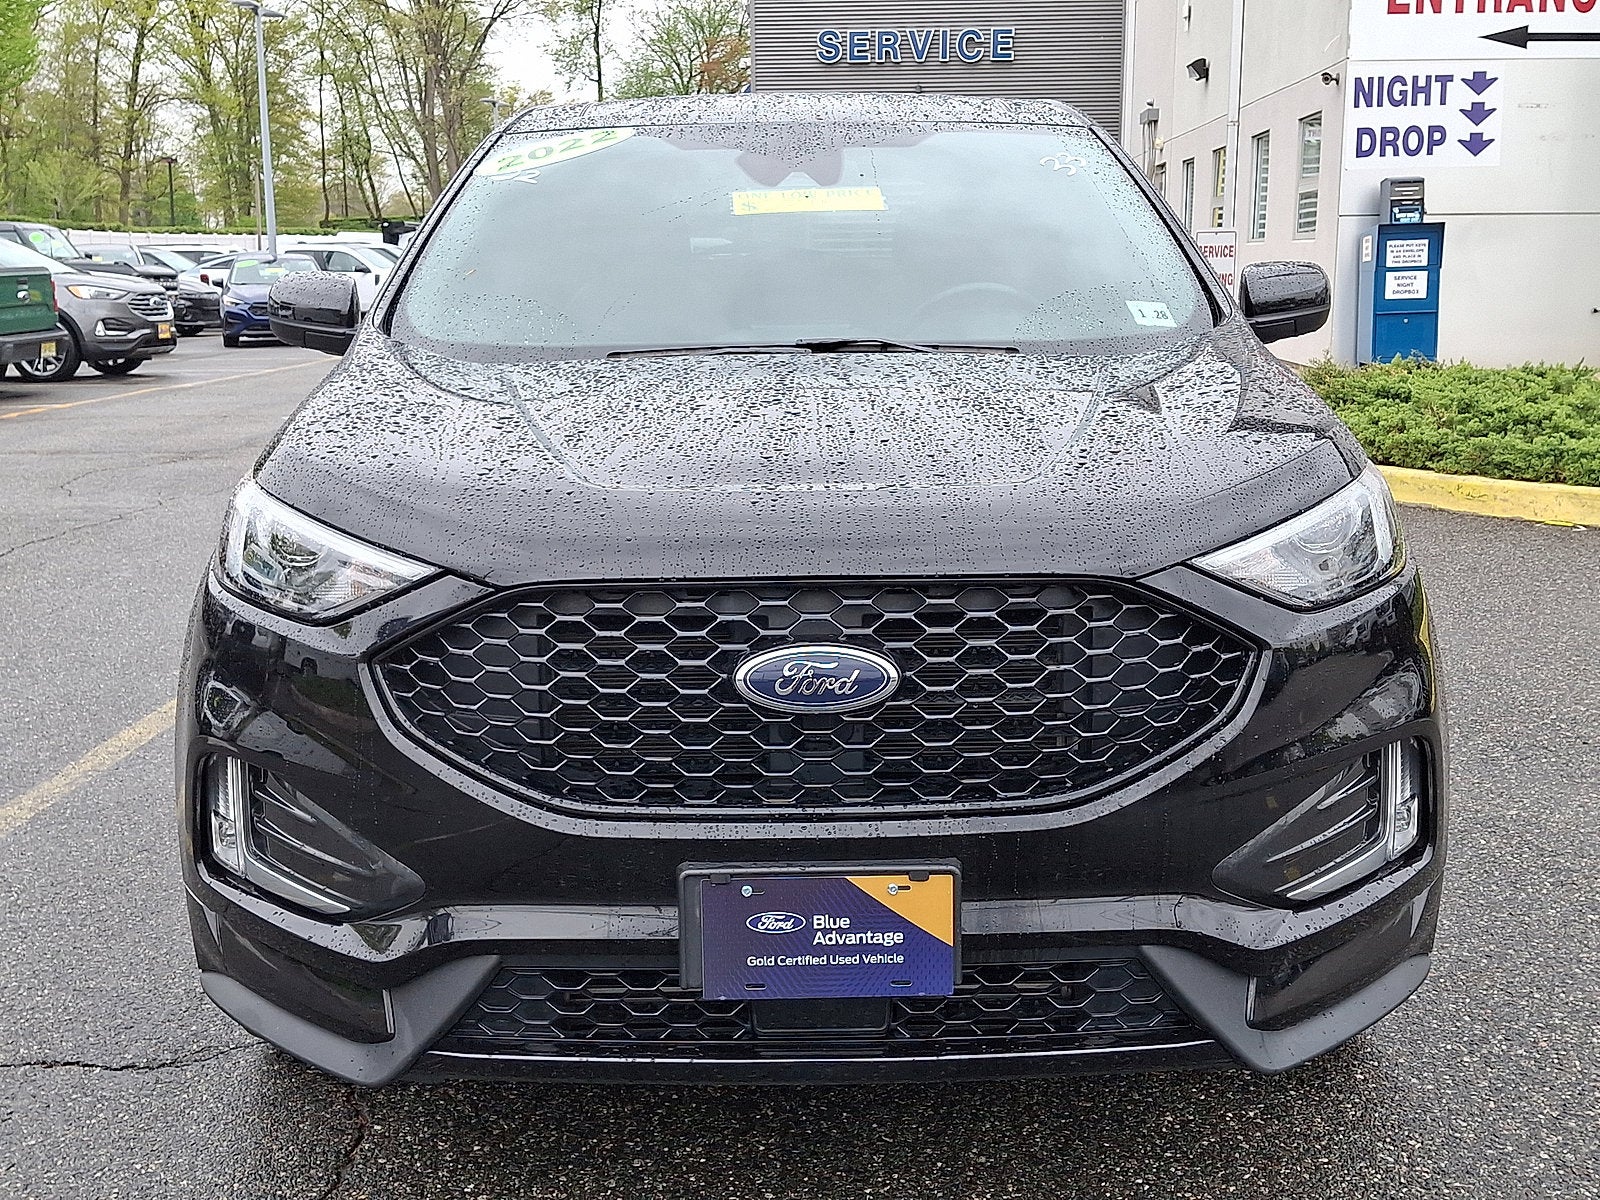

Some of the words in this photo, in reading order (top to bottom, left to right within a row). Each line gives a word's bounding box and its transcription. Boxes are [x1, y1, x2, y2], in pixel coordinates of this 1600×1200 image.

[816, 27, 1016, 64] SERVICE
[1353, 74, 1454, 108] NIGHT
[497, 130, 618, 172] 2022
[1356, 125, 1447, 158] DROP
[1154, 310, 1168, 320] 28
[774, 660, 860, 696] Ford
[757, 915, 795, 930] Ford
[813, 915, 850, 929] Blue
[812, 931, 904, 947] Advantage
[747, 956, 775, 967] Gold
[777, 954, 828, 967] Certified
[829, 954, 860, 966] Used
[862, 953, 904, 965] Vehicle
